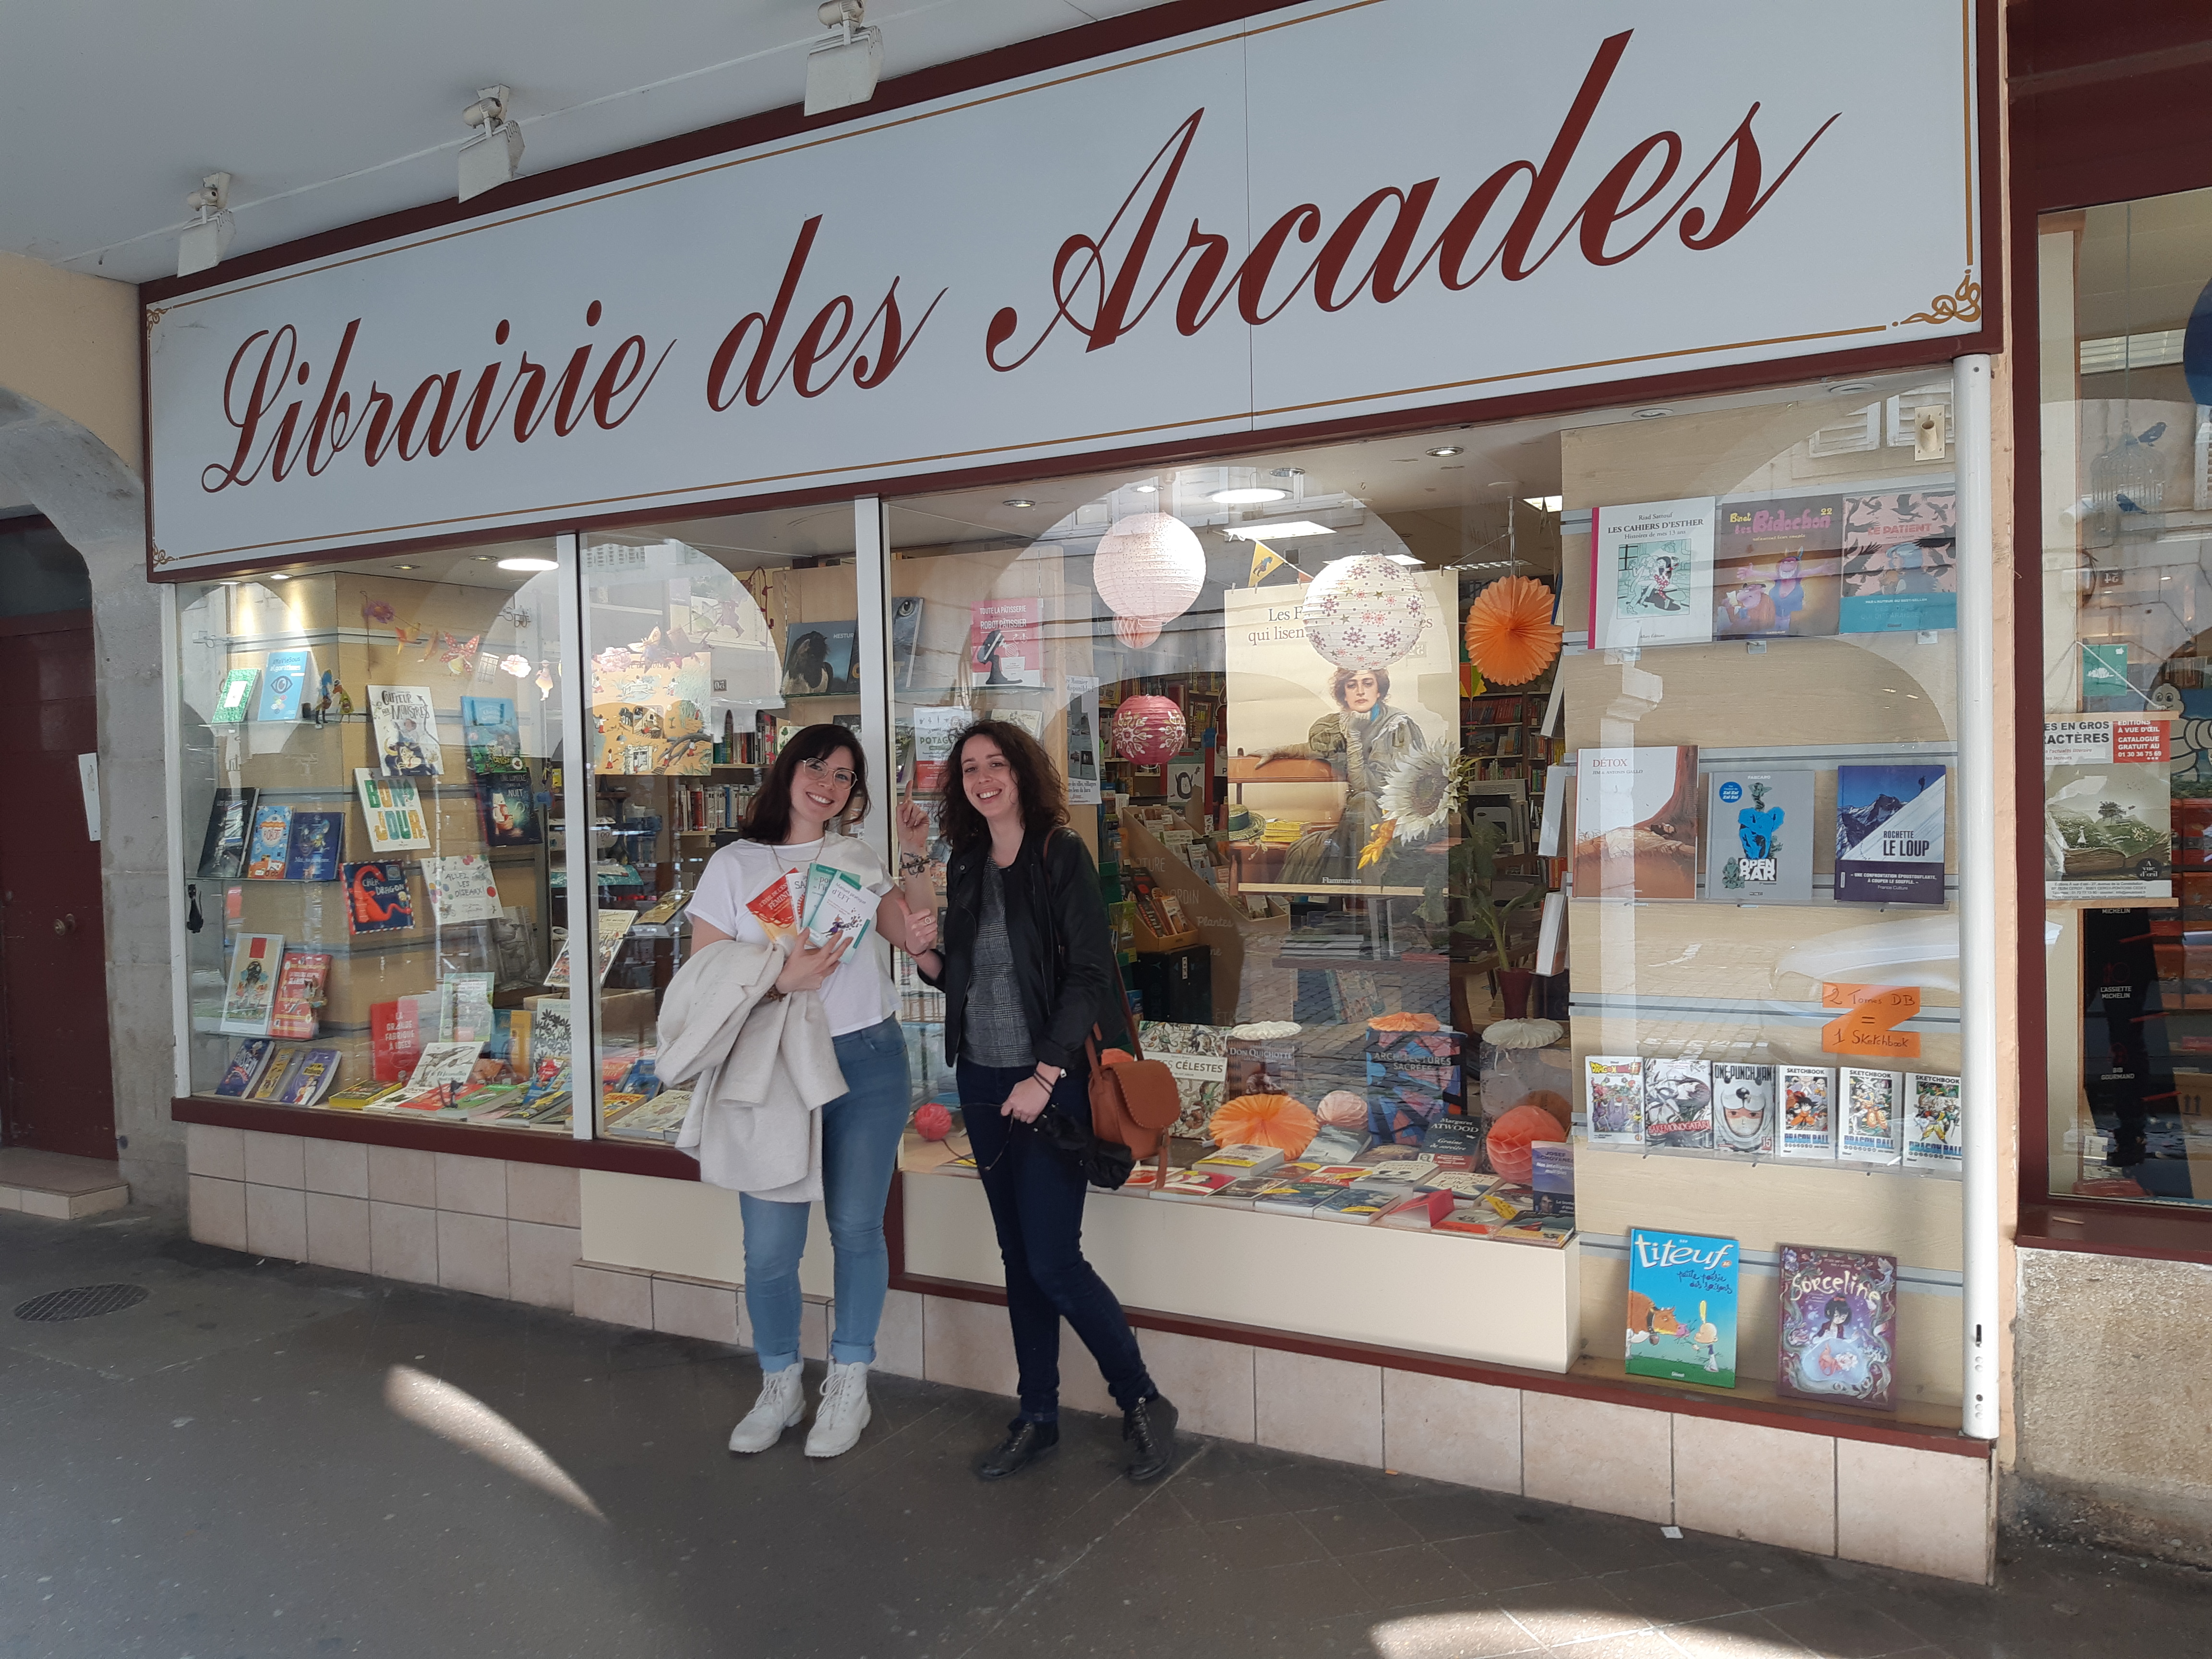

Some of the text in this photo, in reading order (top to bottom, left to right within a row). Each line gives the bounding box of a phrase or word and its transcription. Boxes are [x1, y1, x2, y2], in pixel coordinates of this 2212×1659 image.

[202, 28, 1842, 493] Librairie des Arcades
[1730, 507, 1833, 523] Binet 22
[1753, 508, 1831, 533] Bidochon
[1623, 522, 1660, 532] CAHIERS
[1662, 518, 1704, 529] D'ESTHER
[1867, 523, 1932, 535] LE PATIENT
[1001, 605, 1027, 613] PÂTISSERIE
[1268, 608, 1290, 622] Les
[981, 618, 1027, 629] ROBOT PÂTISSIER
[1248, 627, 1305, 646] qui lisen
[2061, 721, 2109, 731] EN GROS
[1592, 757, 1628, 767] DÉTOX
[508, 789, 523, 797] NUIT
[373, 809, 426, 842] JOUR
[1884, 830, 1914, 839] ROCHETTE
[1883, 840, 1930, 856] LE LOUP
[1739, 858, 1775, 869] OPEN
[1740, 868, 1775, 880] BAR
[362, 878, 380, 888] CHER
[375, 884, 405, 896] DRAGON
[768, 890, 791, 910] FÉMINI
[1196, 916, 1234, 927] Plantes
[1829, 988, 1915, 1006] 2 Tomes DB
[386, 1021, 412, 1031] GRANDE
[385, 1030, 414, 1041] FABRIQUE
[1832, 1028, 1845, 1046] 1
[1249, 1047, 1292, 1059] QUICHOTTE
[1373, 1052, 1451, 1066] ARCHITECTURES
[1176, 1060, 1223, 1072] CÉLESTES
[1756, 1066, 1772, 1081] MAN
[1849, 1070, 1891, 1078] SKETCHBOOK
[1915, 1075, 1960, 1084] SKETCHBOOK
[1431, 1123, 1479, 1133] ATWOOD
[1648, 1120, 1711, 1133] BAKEMONOGATARI
[1762, 1137, 1771, 1148] 15
[1635, 1234, 1734, 1270] titeuf
[1790, 1270, 1882, 1301] Sorceline
